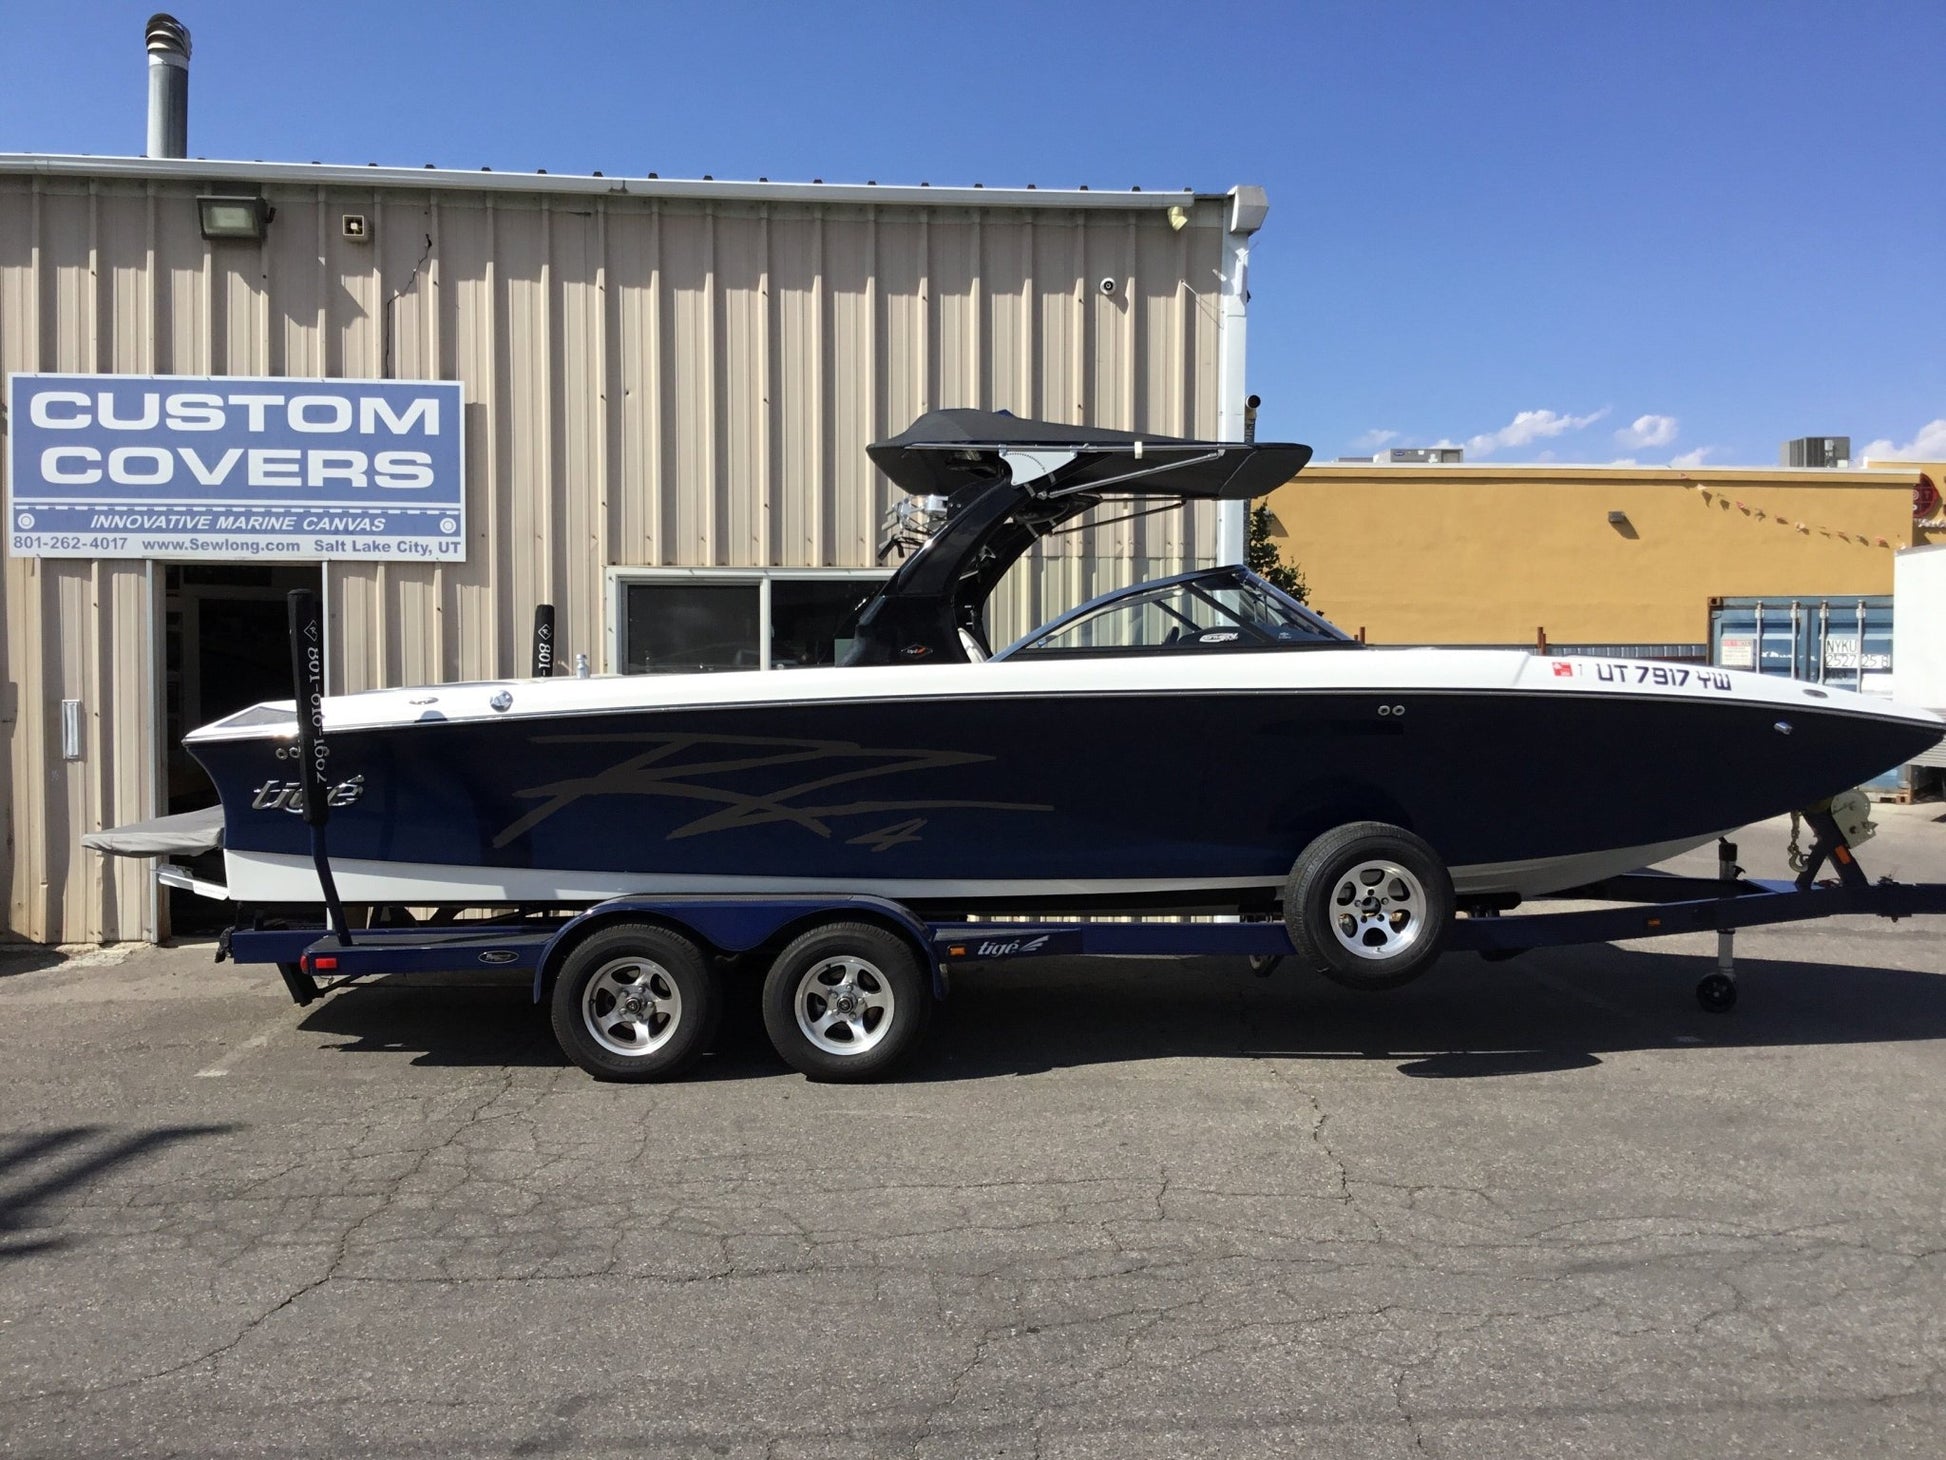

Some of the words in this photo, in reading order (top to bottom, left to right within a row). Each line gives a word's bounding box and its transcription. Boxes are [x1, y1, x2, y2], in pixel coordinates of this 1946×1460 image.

[30, 391, 440, 436] CUSTOM
[40, 446, 435, 489] COVERS
[90, 514, 212, 530] INNOVATIVE
[215, 516, 298, 531] MARINE
[302, 517, 387, 532] CANVAS
[13, 535, 128, 550] 801-262-4017
[142, 537, 301, 554] www.Sewlong.com
[313, 539, 347, 553] Salt
[351, 540, 392, 553] Lake
[396, 540, 433, 556] City,
[437, 541, 461, 554] UT
[1826, 639, 1857, 653] NYKU
[1596, 663, 1628, 682] UT
[1635, 665, 1690, 687] 7917
[1696, 669, 1732, 691] YW
